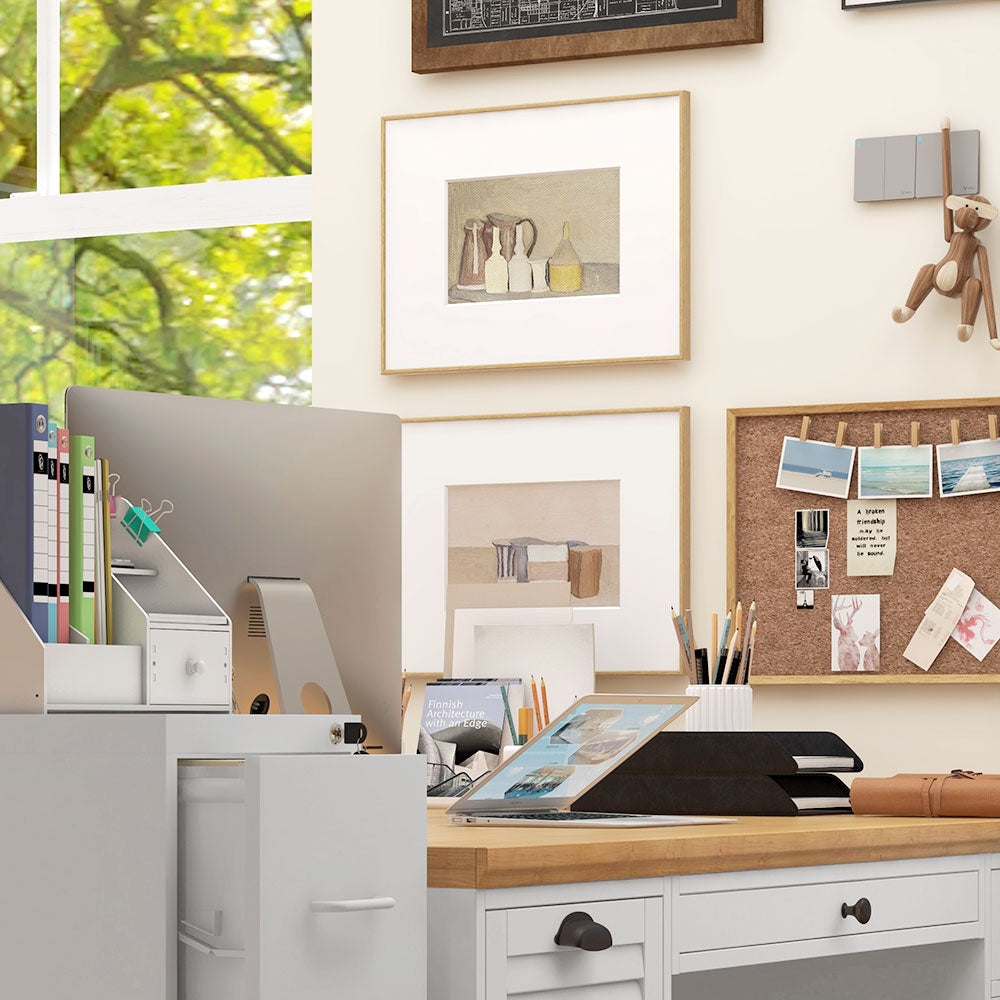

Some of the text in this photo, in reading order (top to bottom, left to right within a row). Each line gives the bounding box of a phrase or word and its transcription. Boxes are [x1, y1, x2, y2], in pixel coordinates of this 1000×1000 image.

[428, 699, 463, 709] Finnish
[425, 709, 485, 718] Architecture
[425, 718, 488, 730] with an Edge
